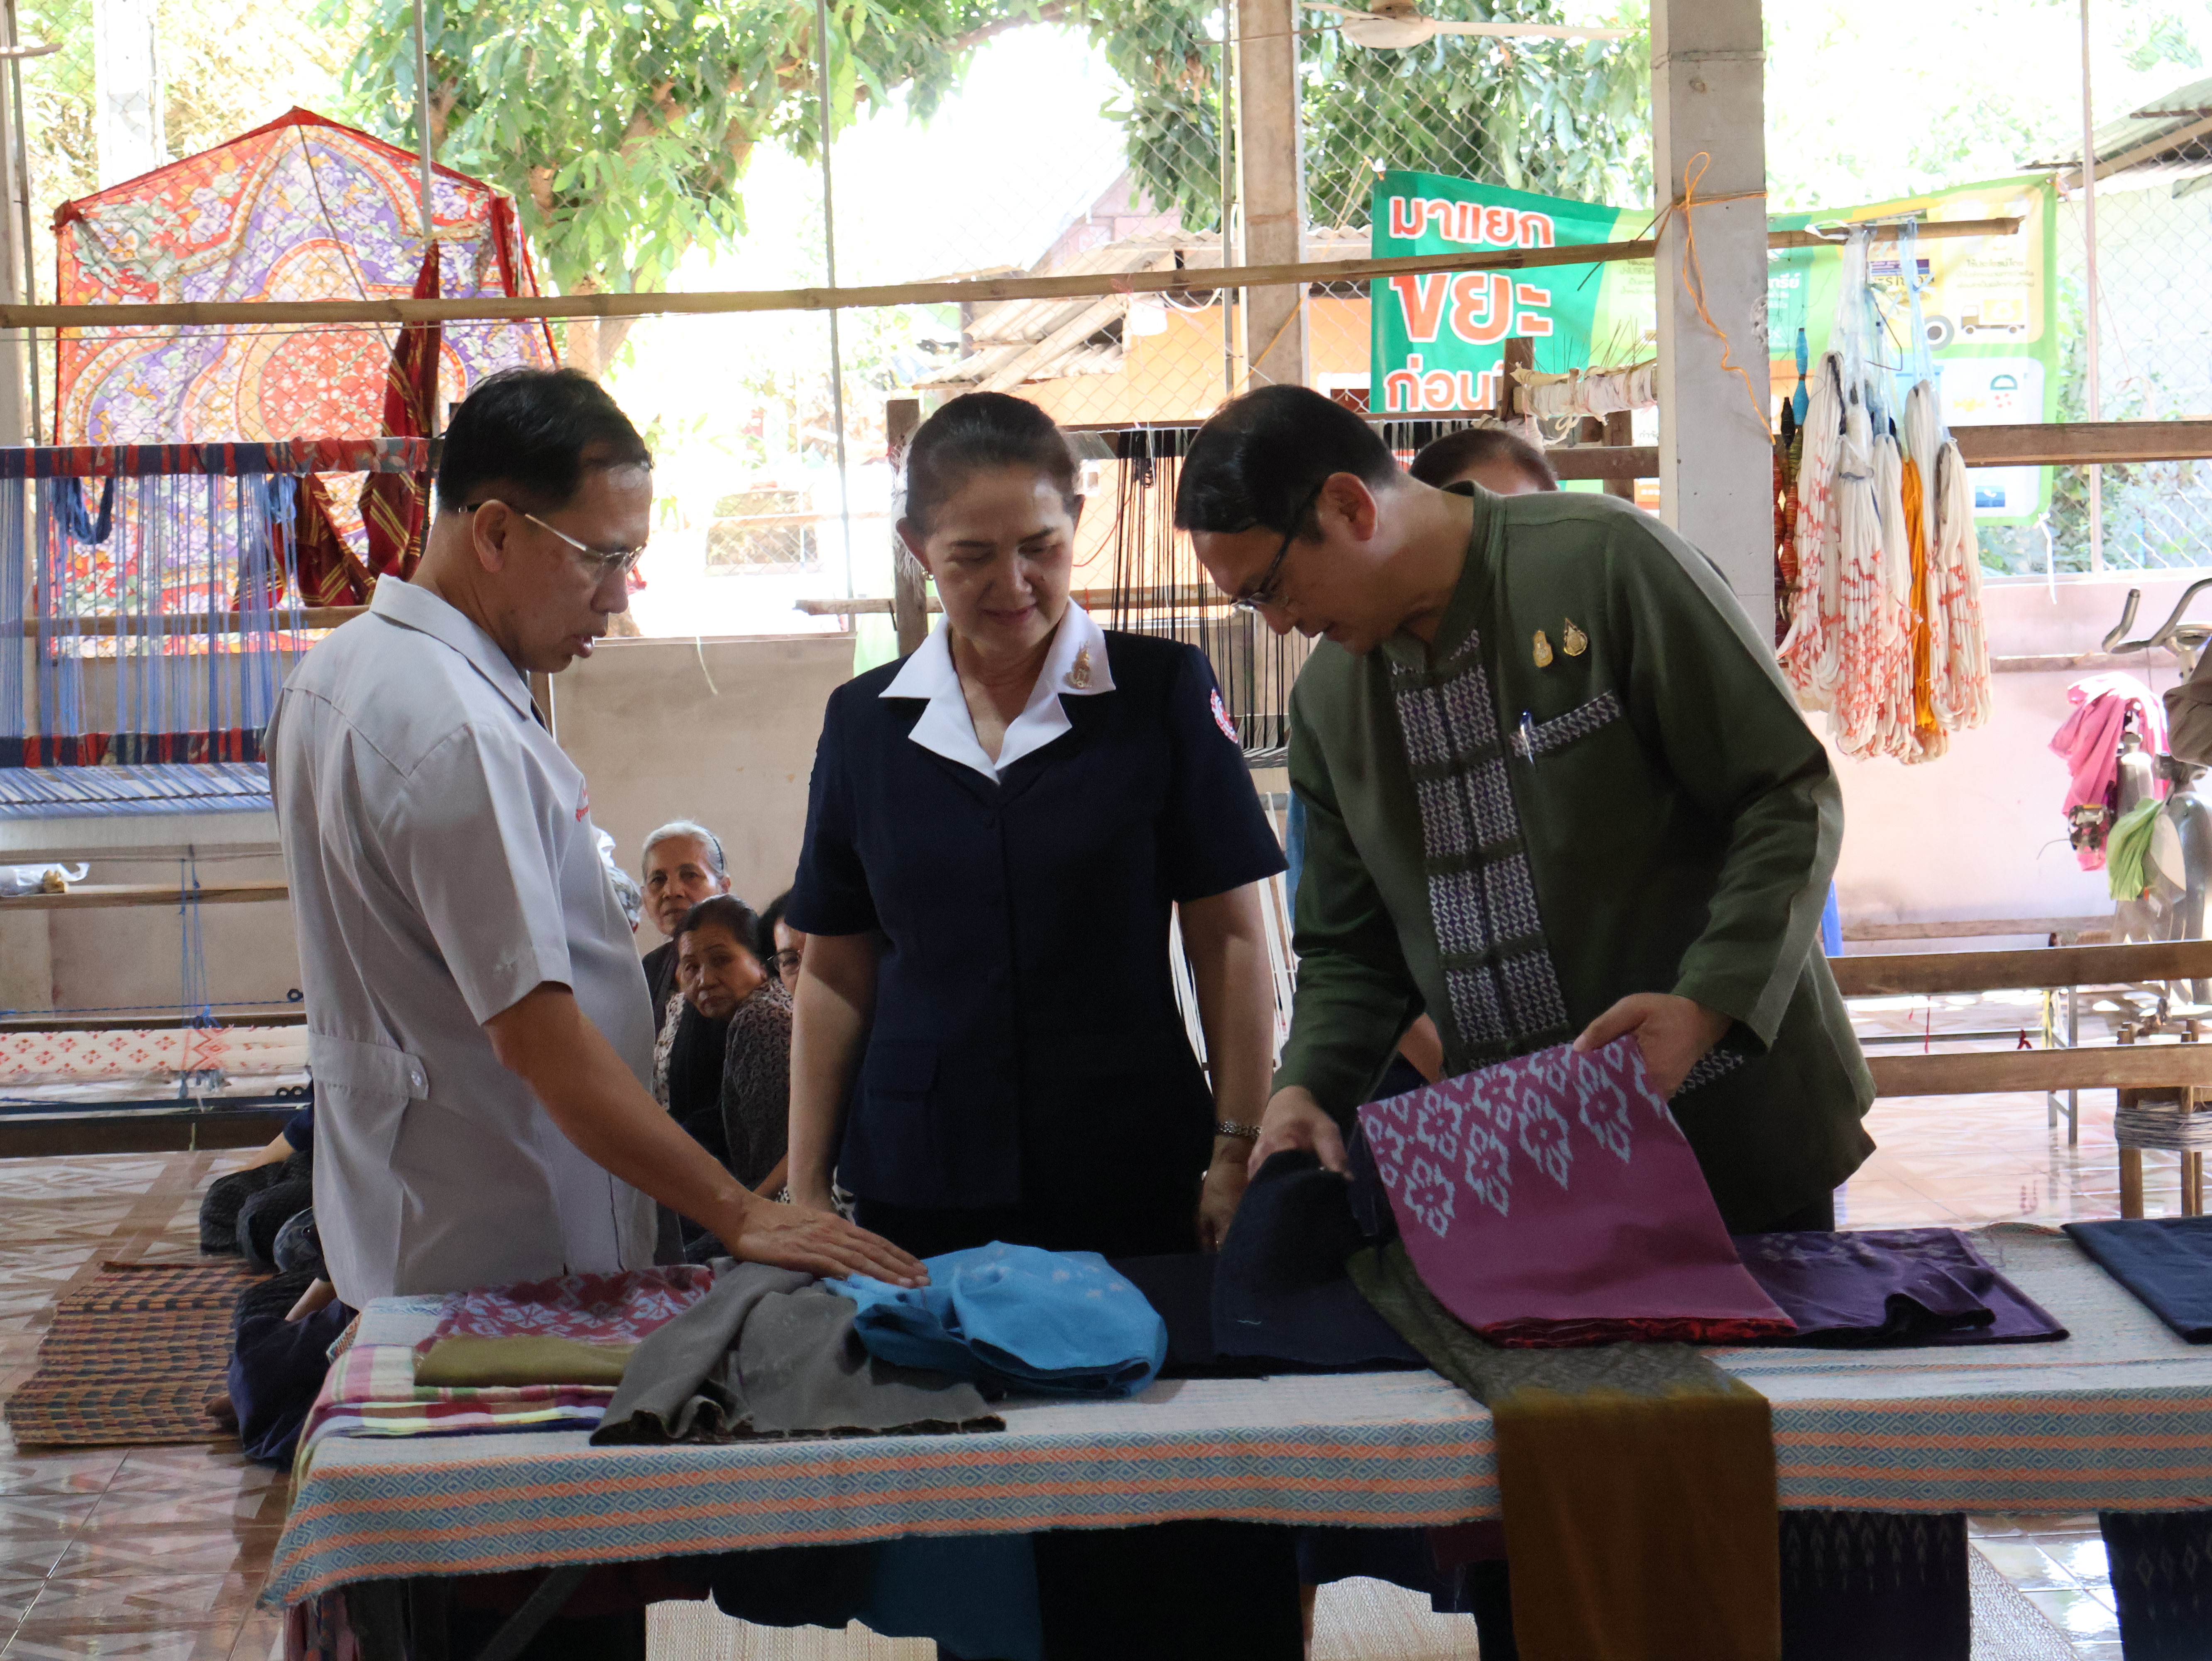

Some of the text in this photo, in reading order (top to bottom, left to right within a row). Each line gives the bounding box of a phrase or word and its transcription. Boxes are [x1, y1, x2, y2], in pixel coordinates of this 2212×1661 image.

[1389, 196, 1555, 248] มาแยก
[1389, 271, 1553, 345] ขยะ
[1383, 354, 1504, 412] ก่อน
